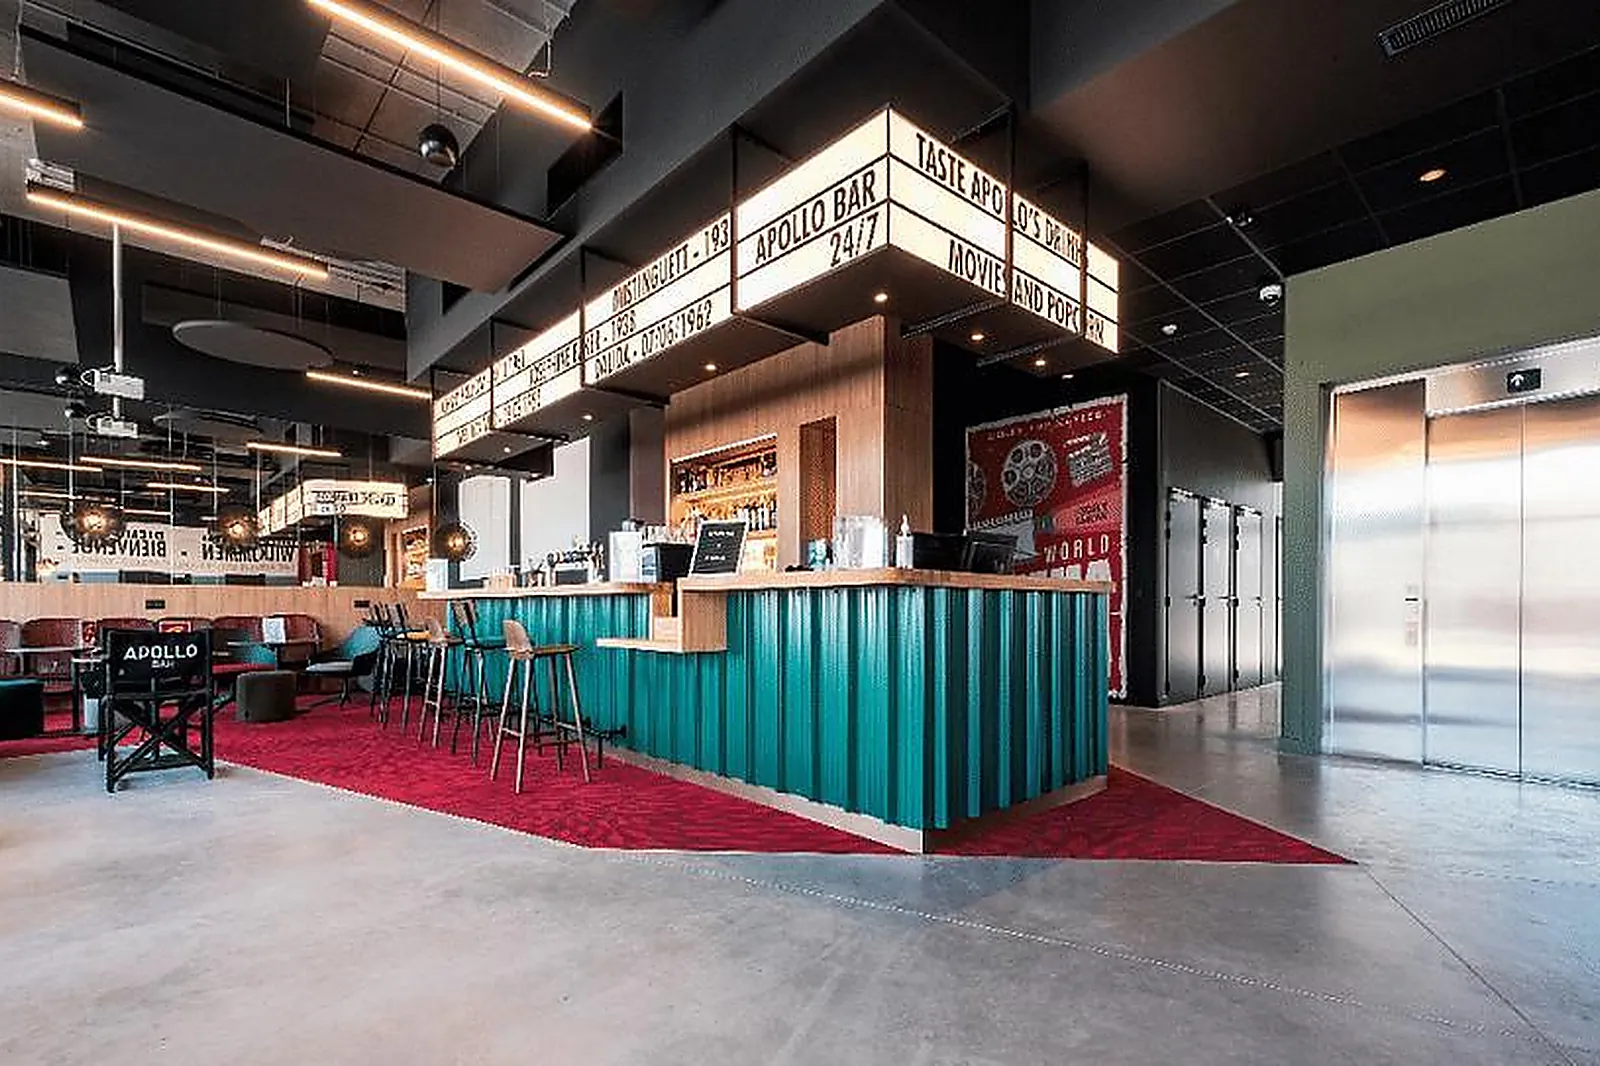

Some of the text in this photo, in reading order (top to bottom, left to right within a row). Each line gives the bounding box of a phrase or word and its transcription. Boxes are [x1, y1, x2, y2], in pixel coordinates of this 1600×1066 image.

[916, 132, 966, 194] TASTE
[971, 171, 1041, 239] APOLO'S
[704, 219, 729, 256] 193
[755, 169, 876, 264] APOLLO BAR
[830, 212, 879, 267] 24/7
[1014, 274, 1043, 313] AND
[1047, 287, 1104, 344] POPCRN
[1043, 534, 1109, 564] WORLD
[123, 644, 198, 661] APOLLO
